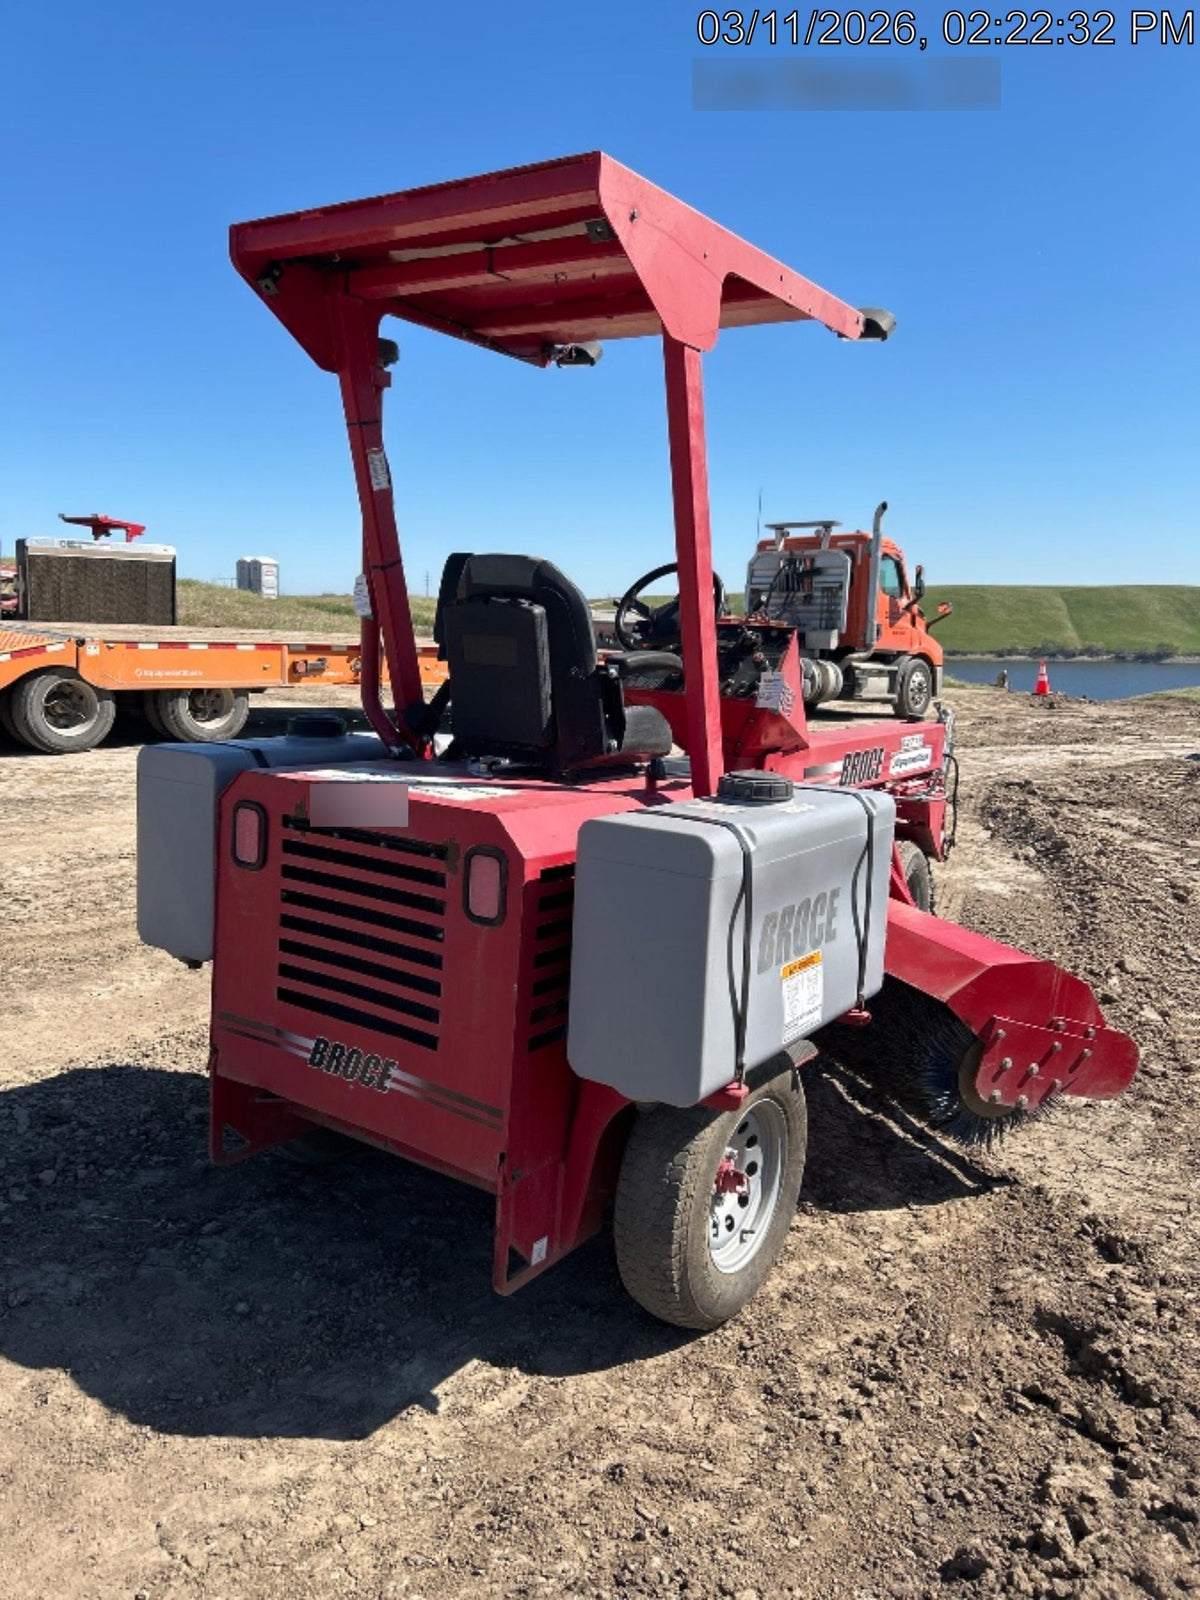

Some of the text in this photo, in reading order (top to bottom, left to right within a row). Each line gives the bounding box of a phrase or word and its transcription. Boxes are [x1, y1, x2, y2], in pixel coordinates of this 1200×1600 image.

[839, 747, 885, 787] BROCE
[757, 887, 841, 975] BROCE
[307, 1036, 399, 1094] BROCE
